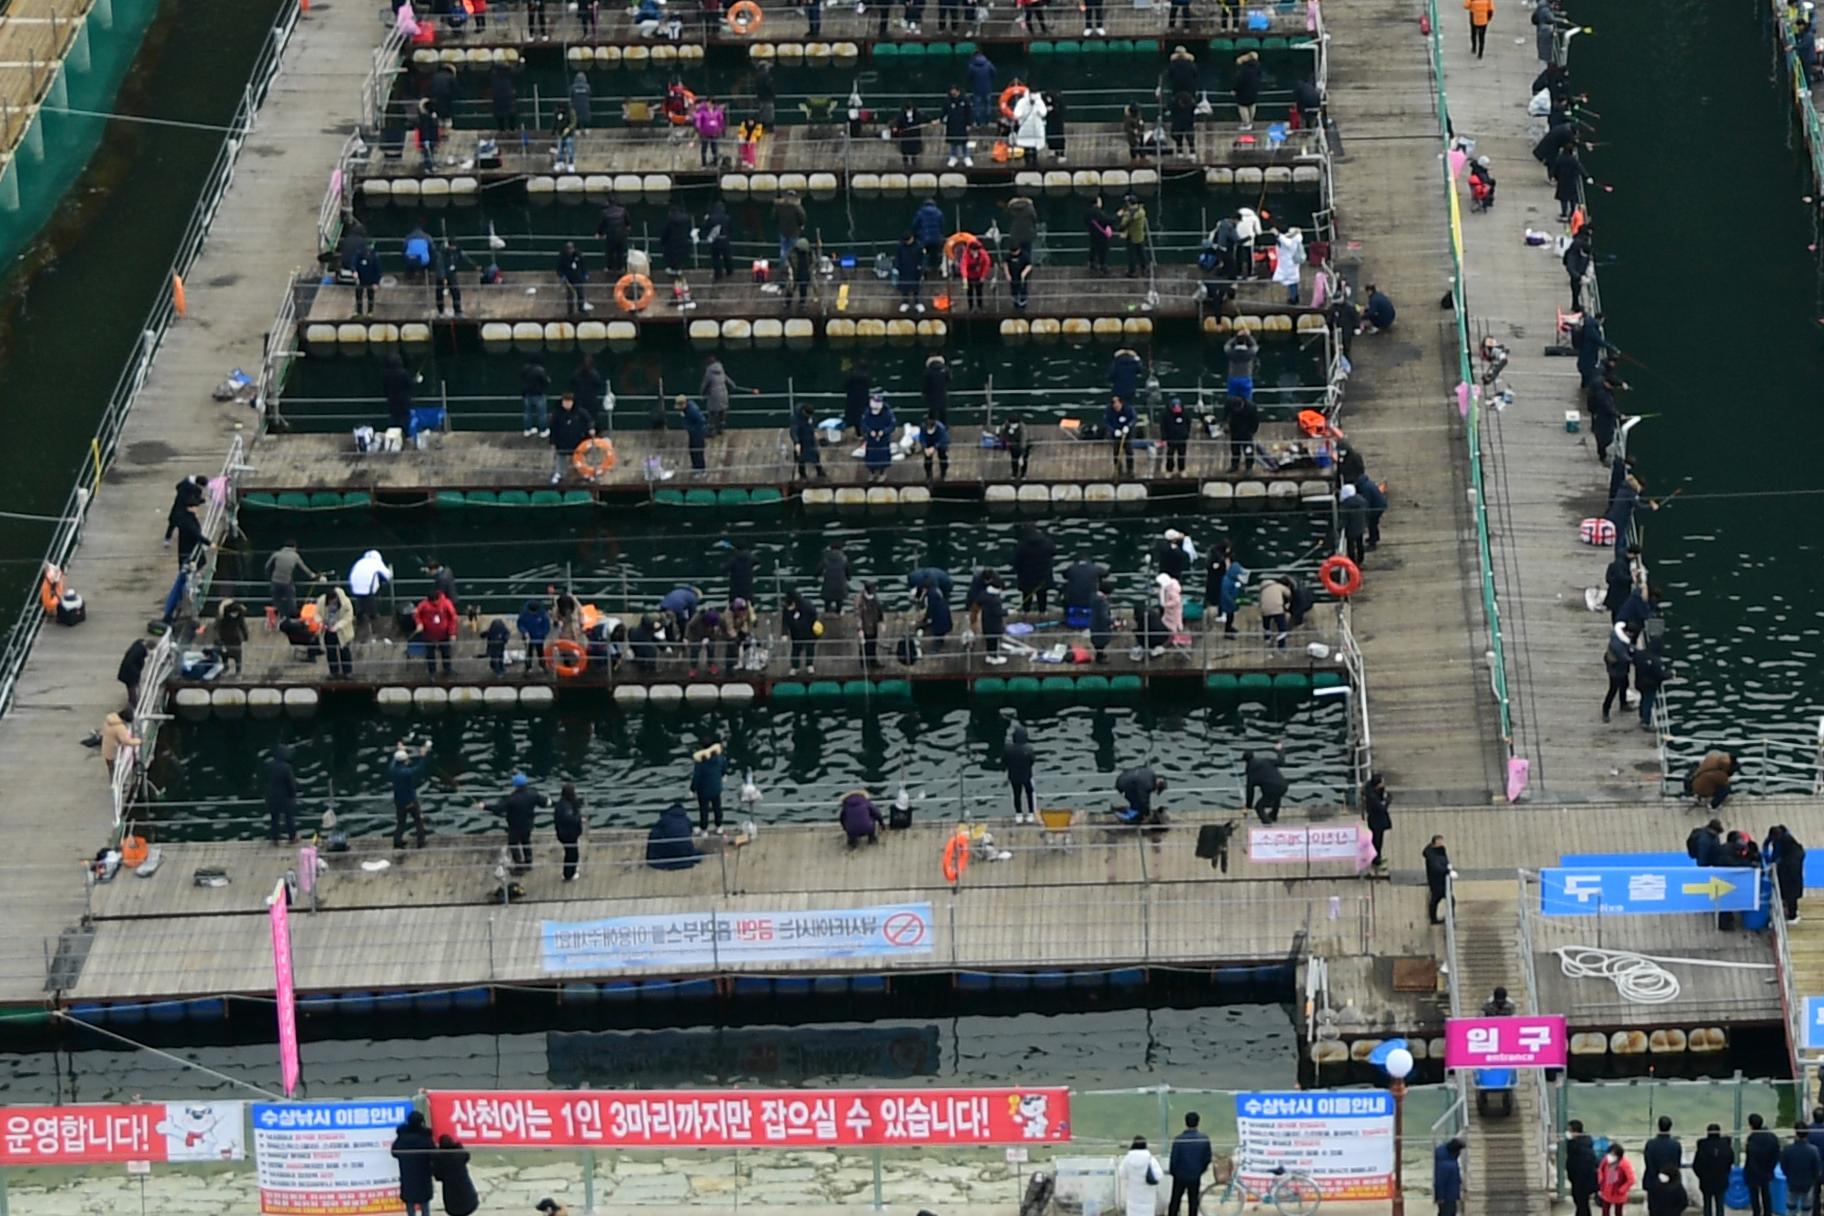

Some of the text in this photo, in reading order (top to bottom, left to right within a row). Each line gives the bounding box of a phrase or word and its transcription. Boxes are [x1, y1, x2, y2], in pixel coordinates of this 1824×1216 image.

[1485, 1054, 1535, 1062] entrance
[1244, 1098, 1313, 1115] 수상낚시
[261, 1108, 331, 1127] 수상낚시
[451, 1097, 990, 1140] 산천어는 1인 3마리까지만 잡으실 수 있습니다!
[5, 1114, 150, 1154] 운영합니다!
